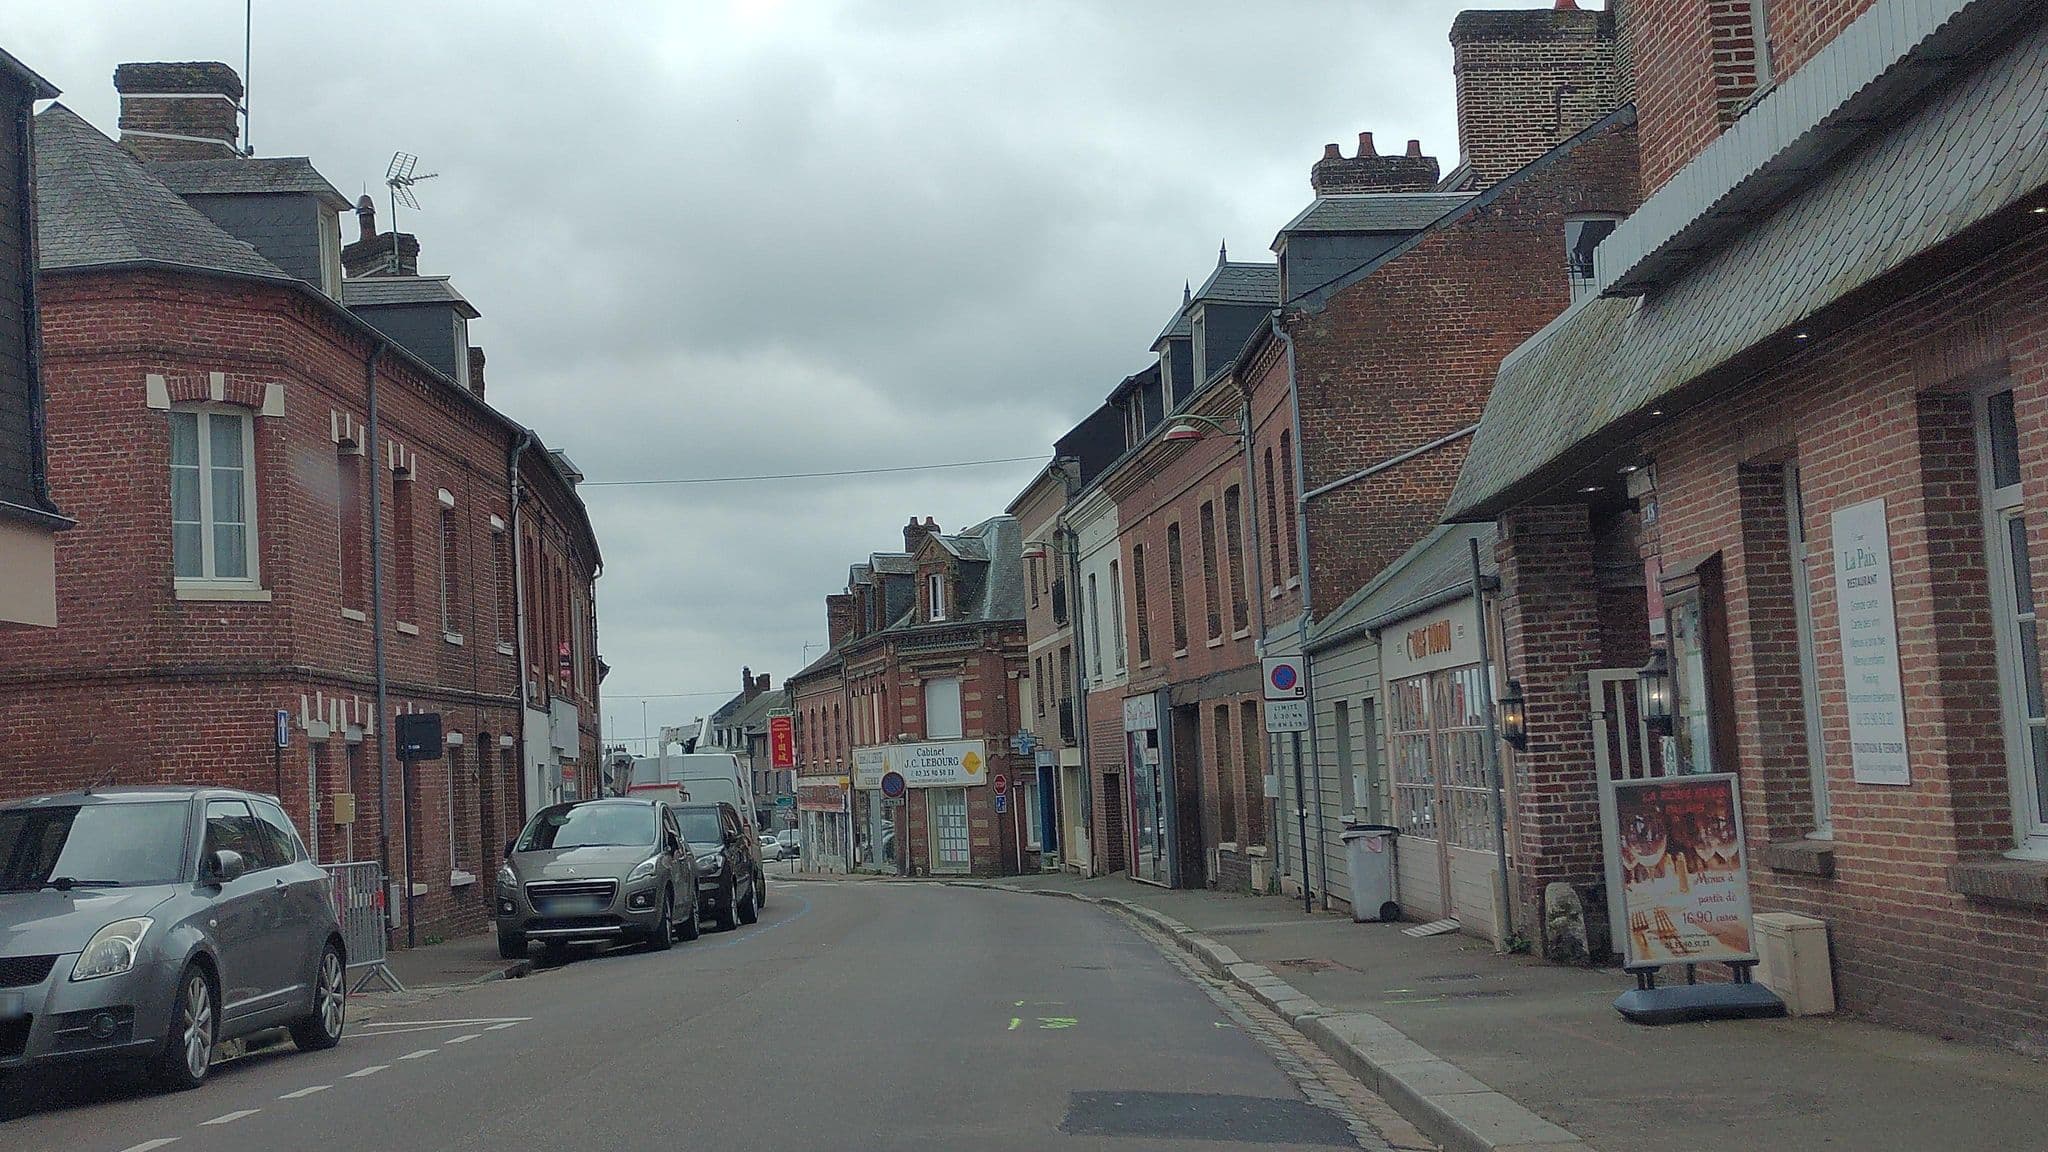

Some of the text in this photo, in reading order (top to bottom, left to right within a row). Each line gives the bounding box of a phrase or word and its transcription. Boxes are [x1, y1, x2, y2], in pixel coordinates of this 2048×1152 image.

[1844, 546, 1878, 571] La Paix
[916, 747, 945, 757] Cabinet
[921, 757, 959, 768] LEBOURG
[1698, 894, 1723, 906] partir
[1716, 913, 1738, 922] euros
